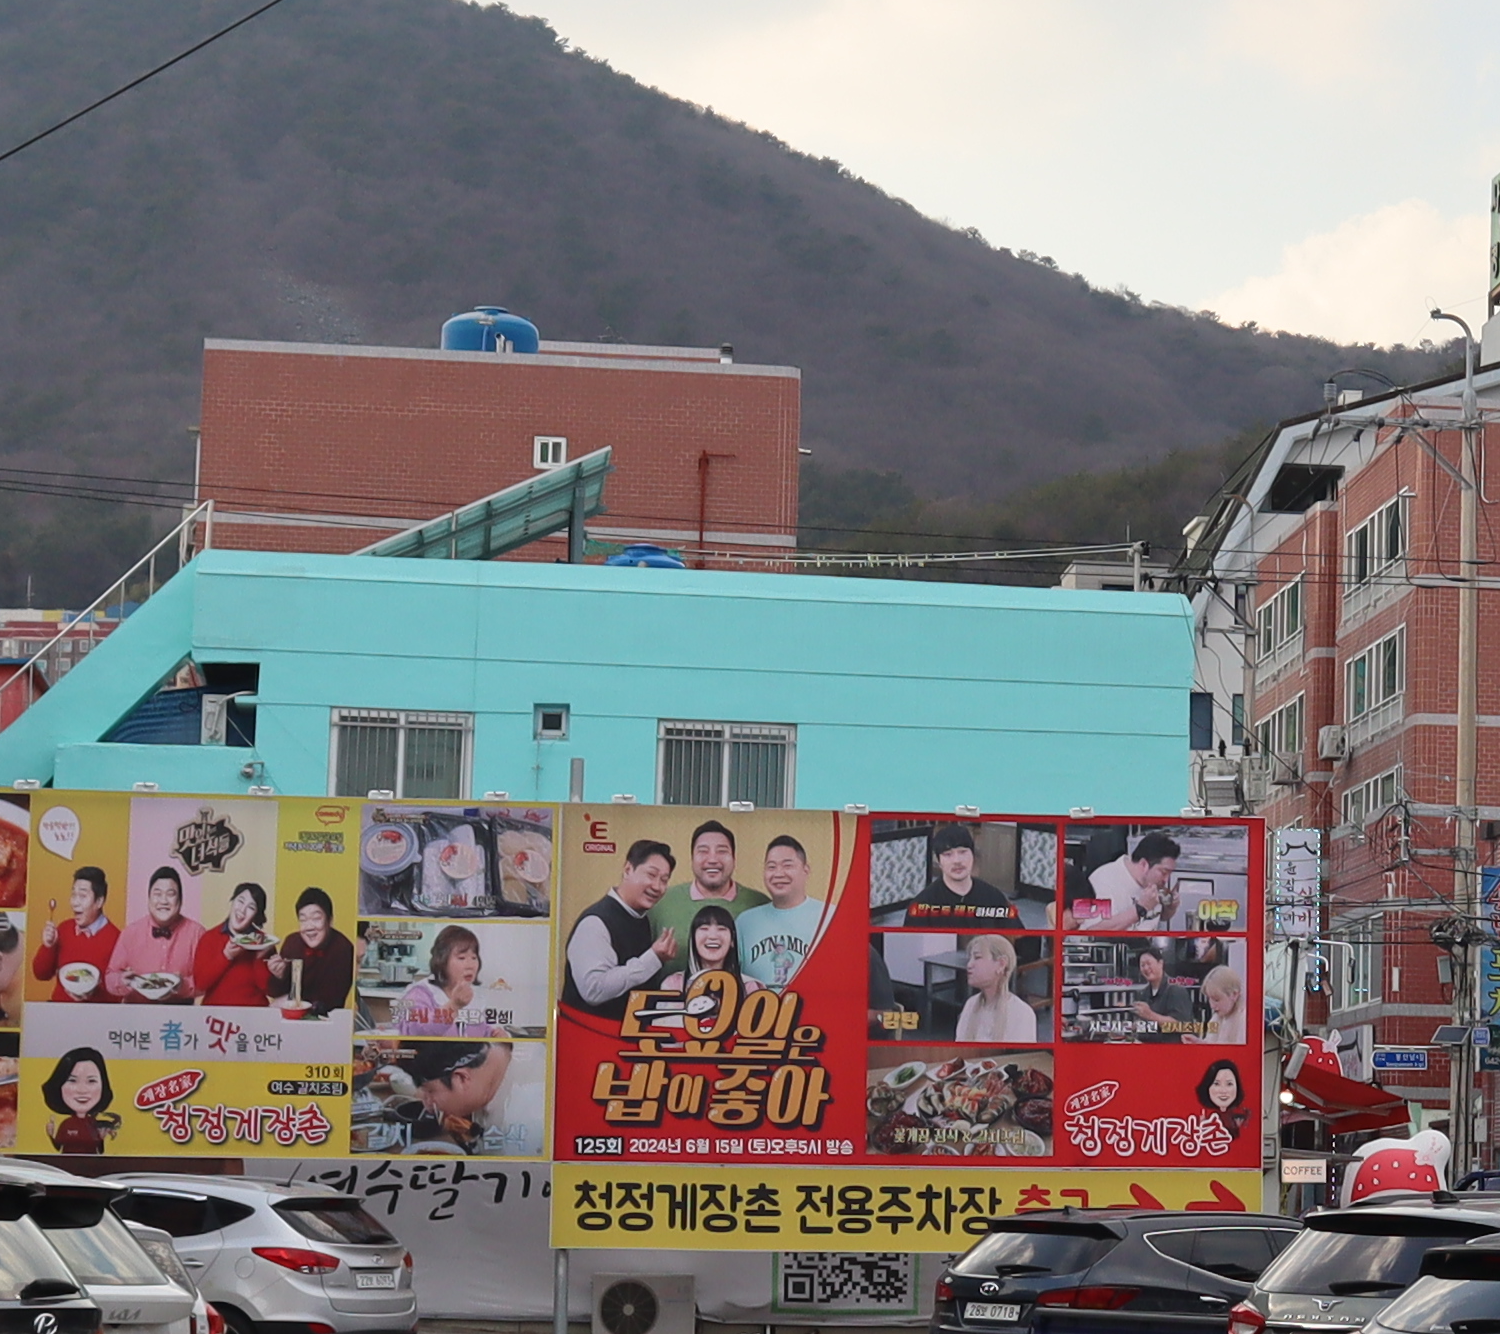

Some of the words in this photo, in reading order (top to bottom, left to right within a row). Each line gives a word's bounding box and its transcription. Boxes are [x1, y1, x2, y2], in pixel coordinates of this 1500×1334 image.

[584, 844, 615, 852] ORIGINAL
[485, 1008, 514, 1025] 완성!
[617, 969, 823, 1062] 토요일은
[108, 1031, 152, 1050] 먹어본
[253, 1032, 283, 1052] 안다
[270, 1081, 295, 1094] 여수
[297, 1081, 344, 1096] 갈치조림
[592, 1060, 704, 1122] 밥이
[707, 1064, 830, 1126] 좋아
[154, 1102, 332, 1143] 청정게장촌
[366, 1122, 413, 1148] 갈치
[574, 1137, 623, 1155] 125회
[628, 1138, 682, 1154] 2024년
[686, 1138, 710, 1154] 6월
[714, 1138, 744, 1155] 15일
[826, 1139, 854, 1156] 방송
[1064, 1113, 1233, 1157] 청정게장촌
[1283, 1165, 1323, 1176] COFFEE
[308, 1160, 551, 1221] 여수딸기
[574, 1181, 782, 1234] 청정게장촌
[796, 1183, 1002, 1236] 전용주차장
[990, 1305, 1015, 1319] 0718
